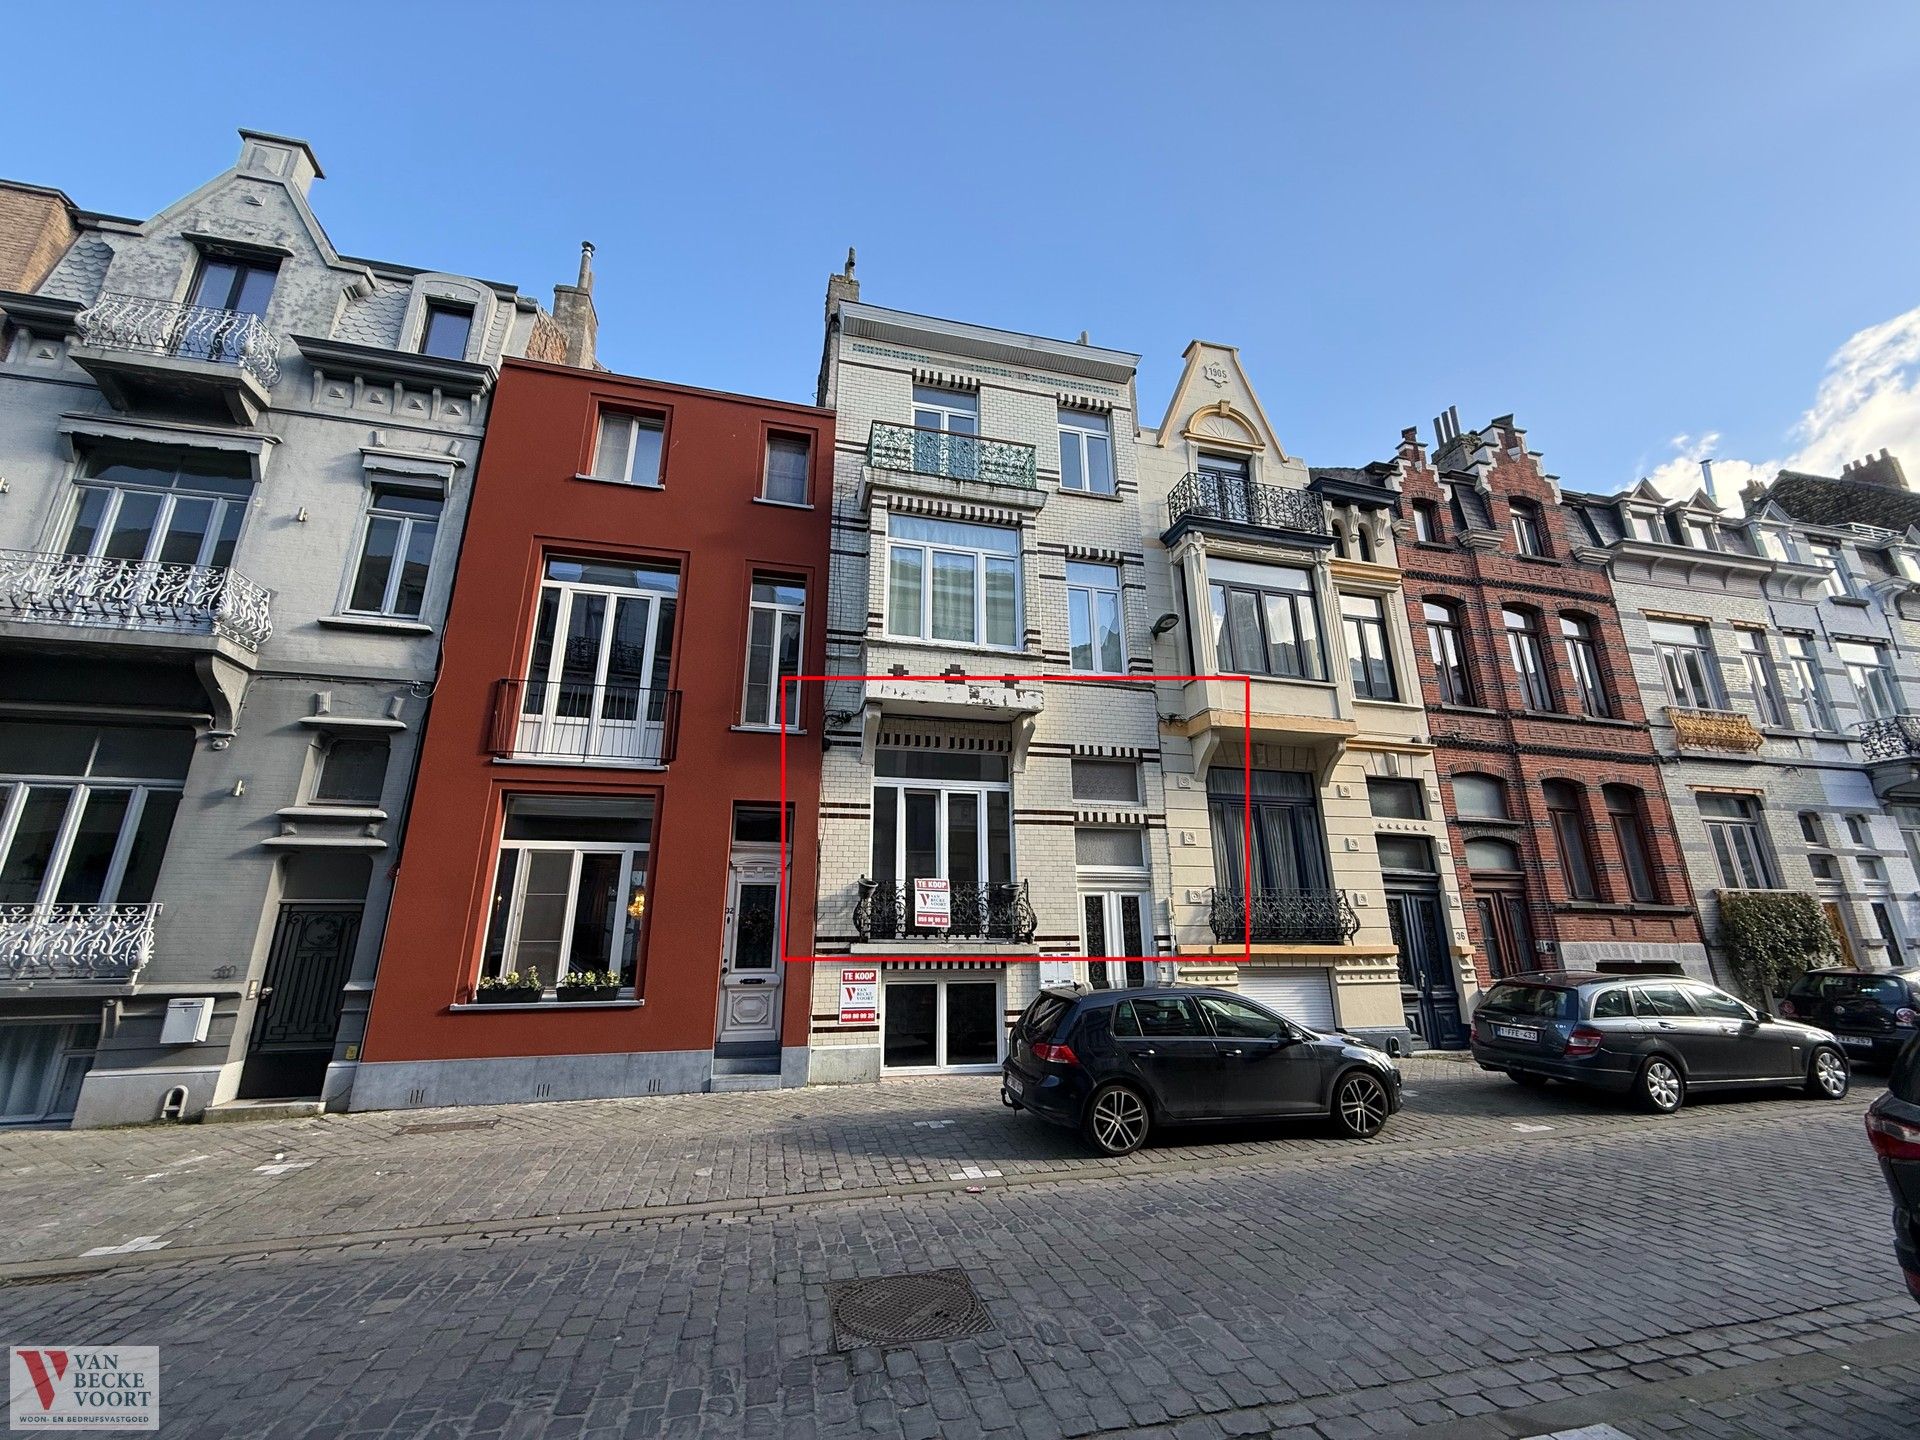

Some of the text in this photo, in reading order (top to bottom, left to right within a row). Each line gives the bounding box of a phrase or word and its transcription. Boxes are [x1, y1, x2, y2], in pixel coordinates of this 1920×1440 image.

[1208, 367, 1227, 379] 1905
[1455, 931, 1466, 941] 36
[844, 972, 875, 980] TE KOOP
